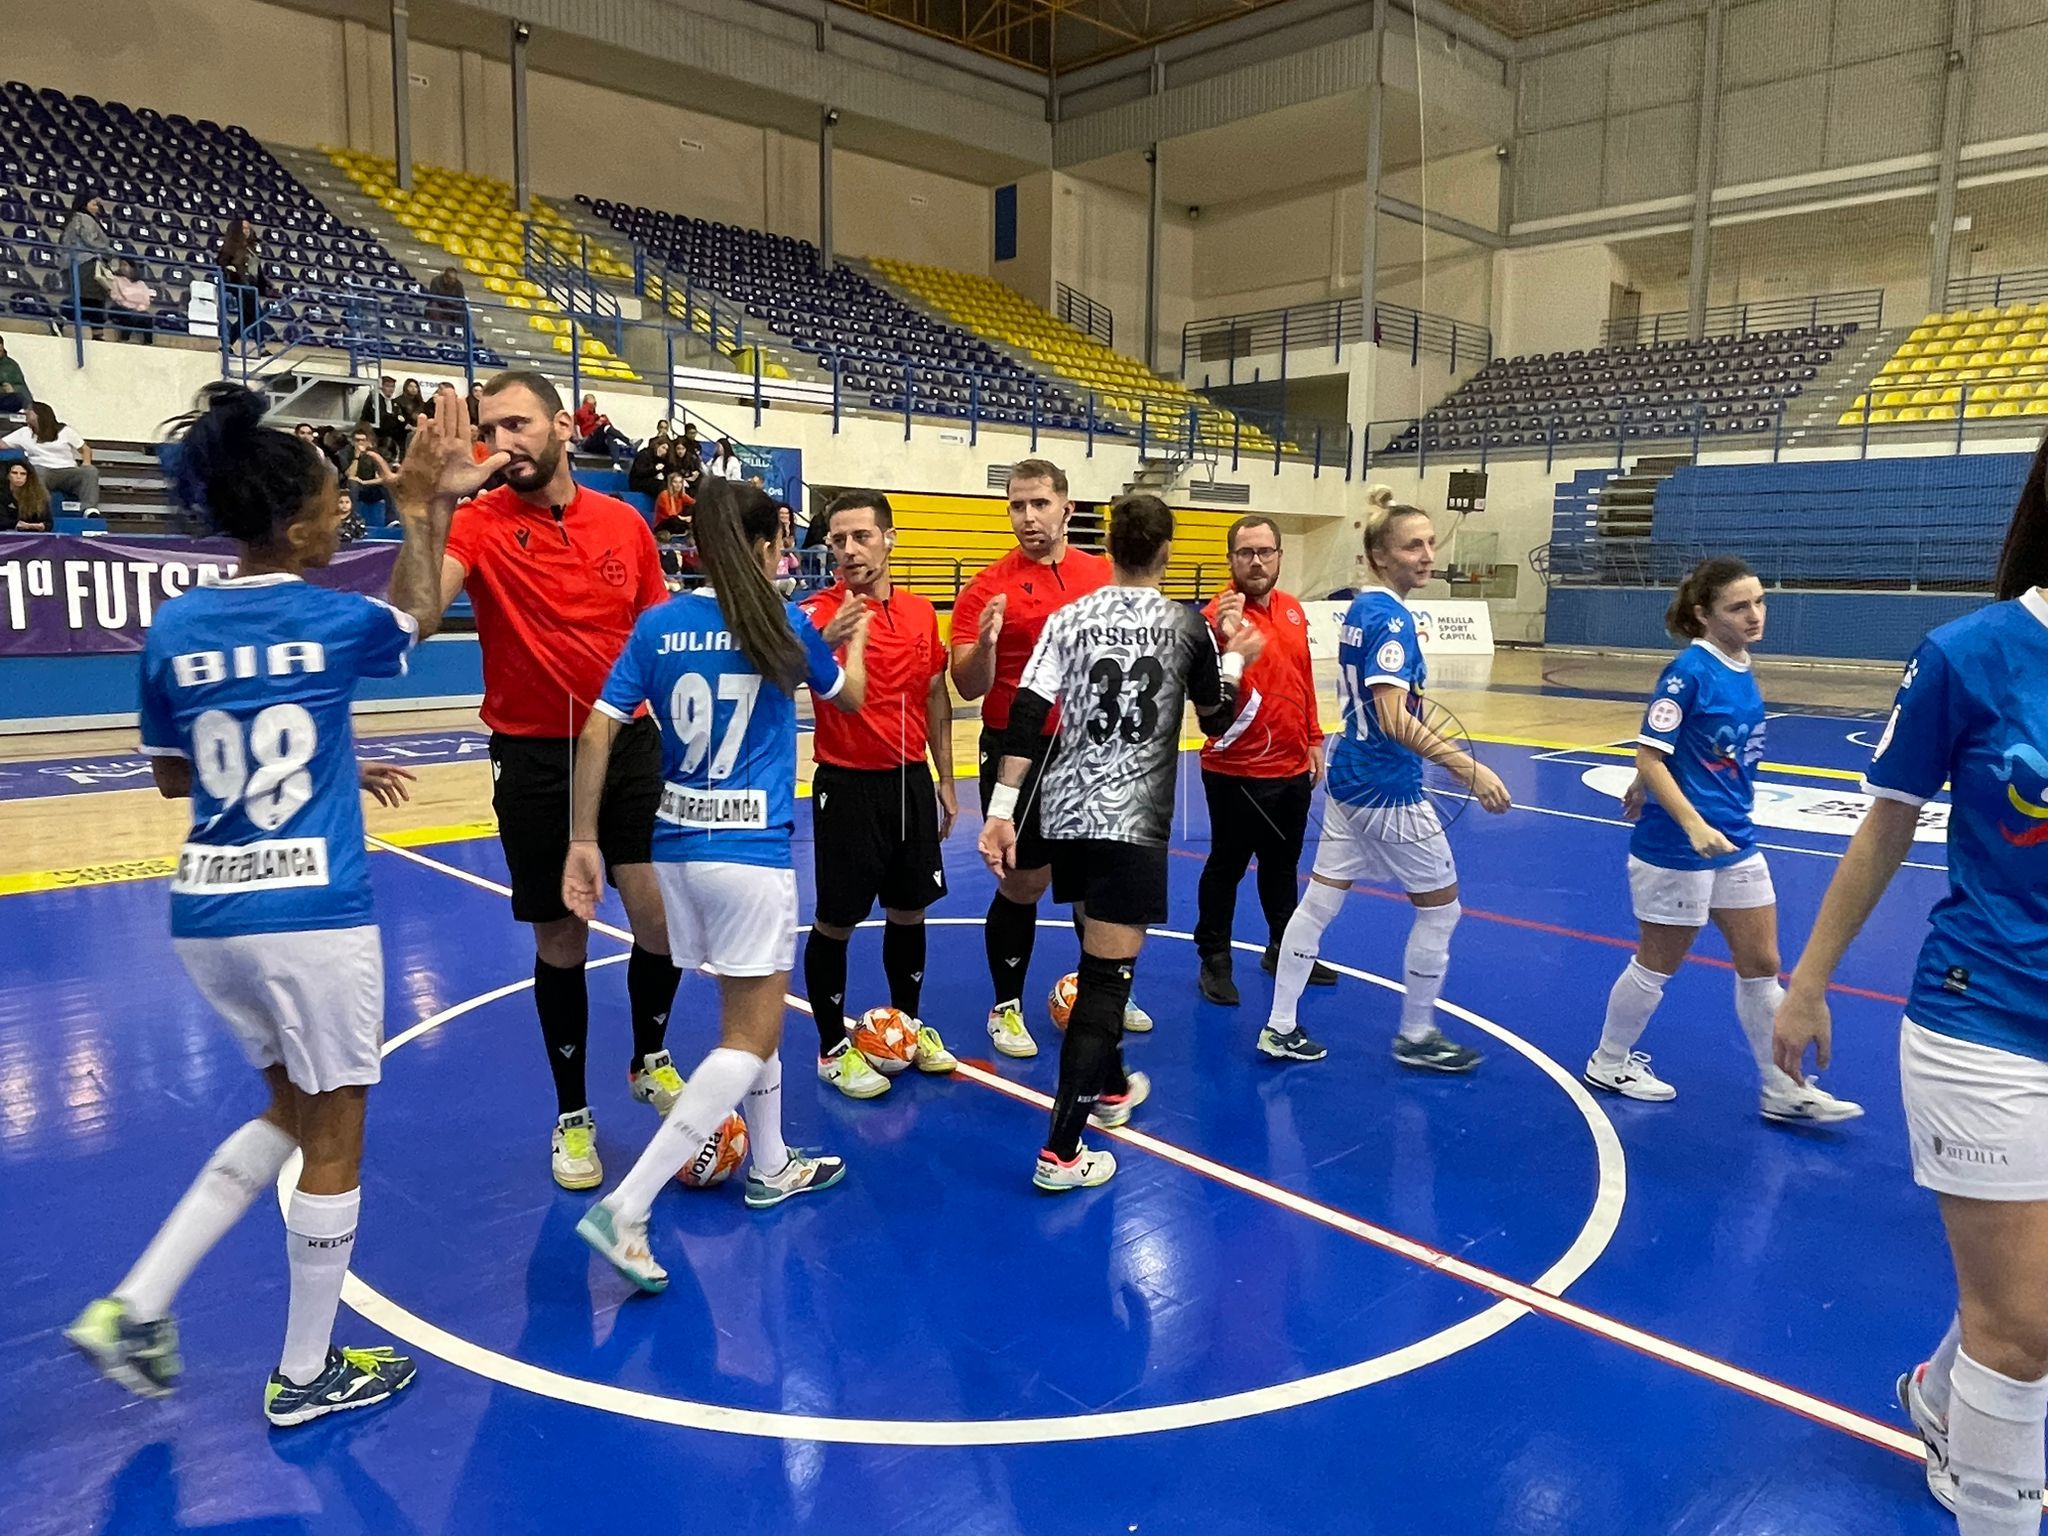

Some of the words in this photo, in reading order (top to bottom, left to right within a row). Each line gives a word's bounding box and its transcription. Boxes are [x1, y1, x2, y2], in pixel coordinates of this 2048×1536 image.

[64, 560, 240, 630] FUTS
[657, 630, 742, 655] JULIA
[1437, 616, 1474, 625] MELILLA
[1439, 624, 1468, 632] SPORT
[1440, 632, 1477, 641] CAPITAL
[172, 641, 325, 688] BIA
[1086, 655, 1164, 746] 33
[670, 672, 763, 779] 97
[191, 703, 318, 834] 98
